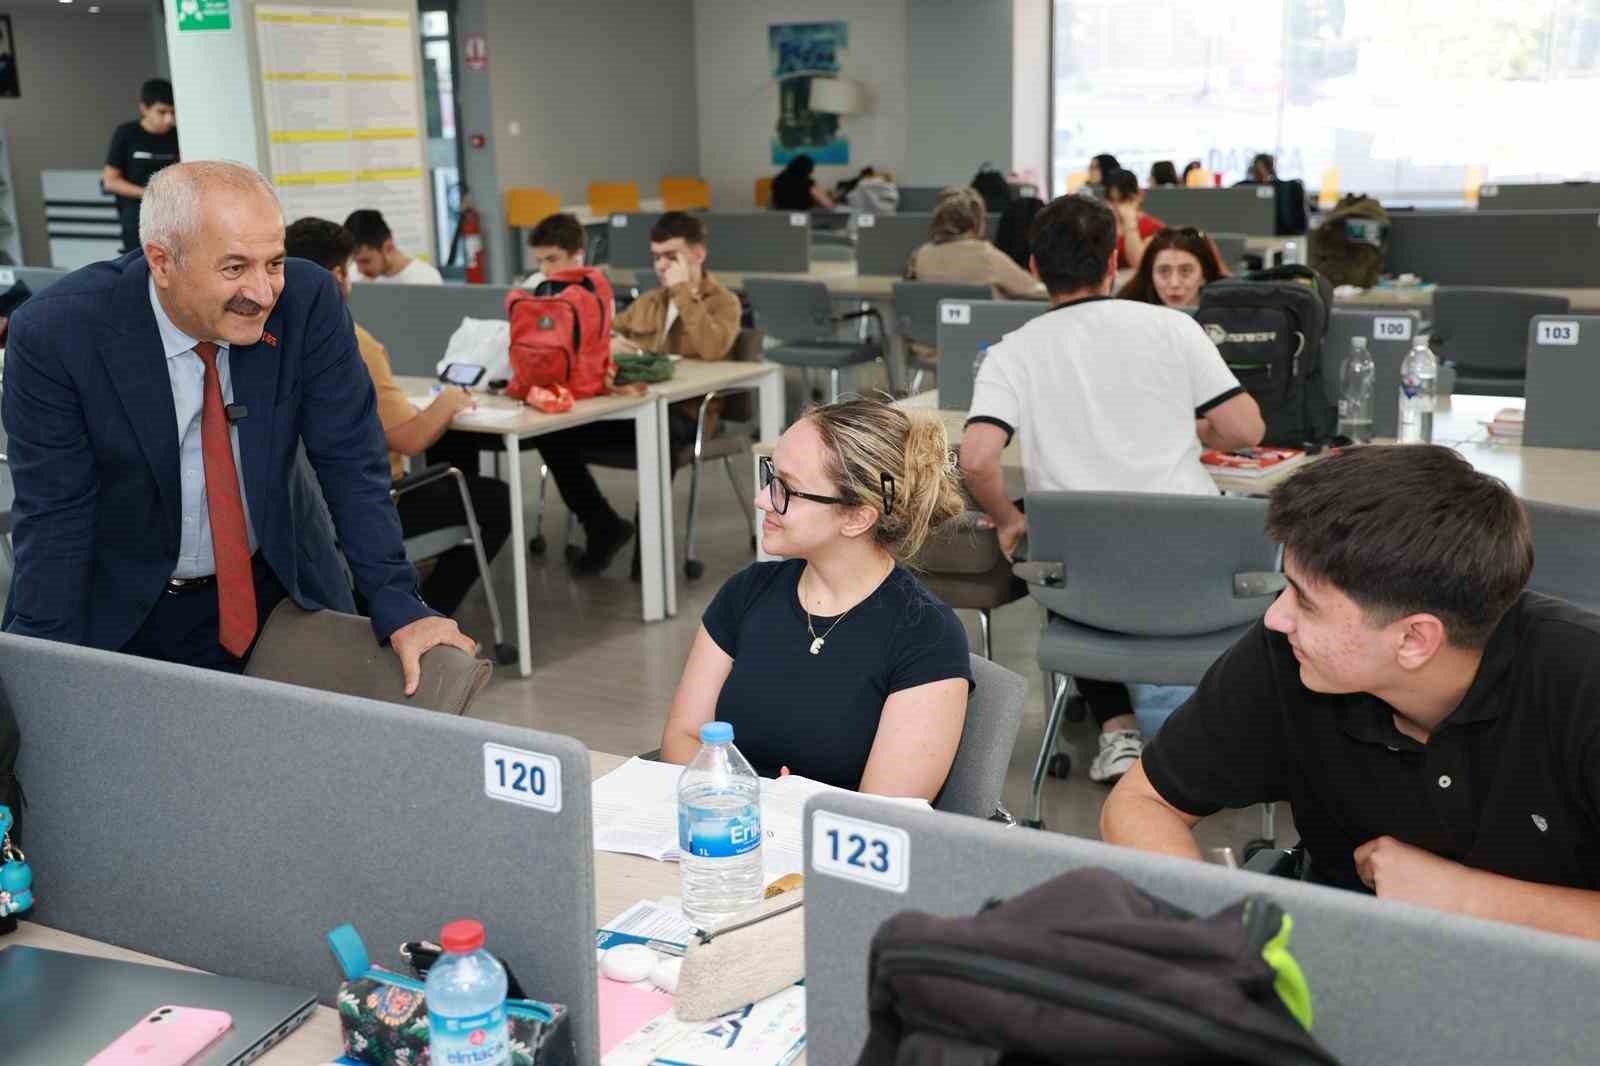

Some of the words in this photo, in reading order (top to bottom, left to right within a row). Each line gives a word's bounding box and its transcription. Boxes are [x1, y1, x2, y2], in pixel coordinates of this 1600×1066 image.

[1380, 323, 1404, 335] 100
[1544, 327, 1571, 339] 103
[494, 758, 546, 796] 120
[827, 829, 890, 873] 123
